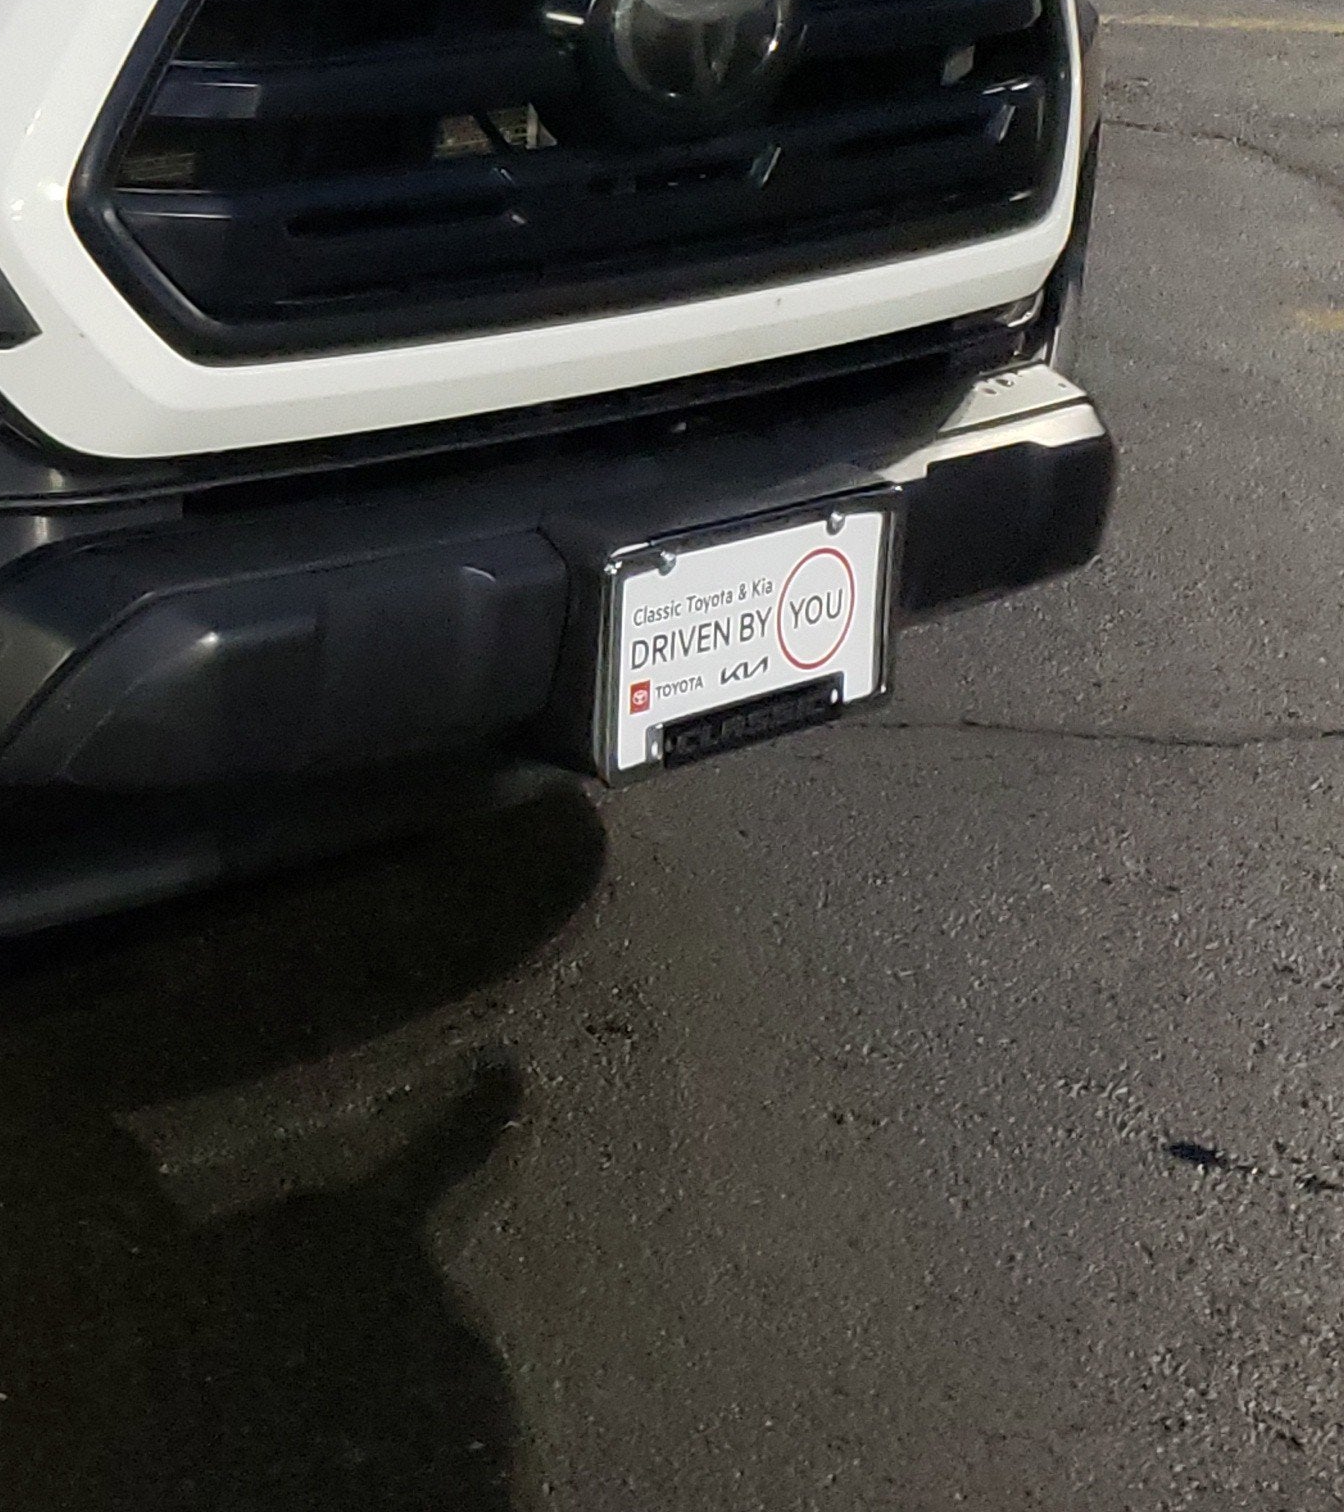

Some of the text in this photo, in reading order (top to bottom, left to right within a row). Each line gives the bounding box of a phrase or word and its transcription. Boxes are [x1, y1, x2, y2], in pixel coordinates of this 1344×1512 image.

[633, 577, 774, 627] Classic Toyota & Kia
[630, 588, 844, 670] DRIVEN BY YOU
[656, 675, 704, 700] TOYOTA
